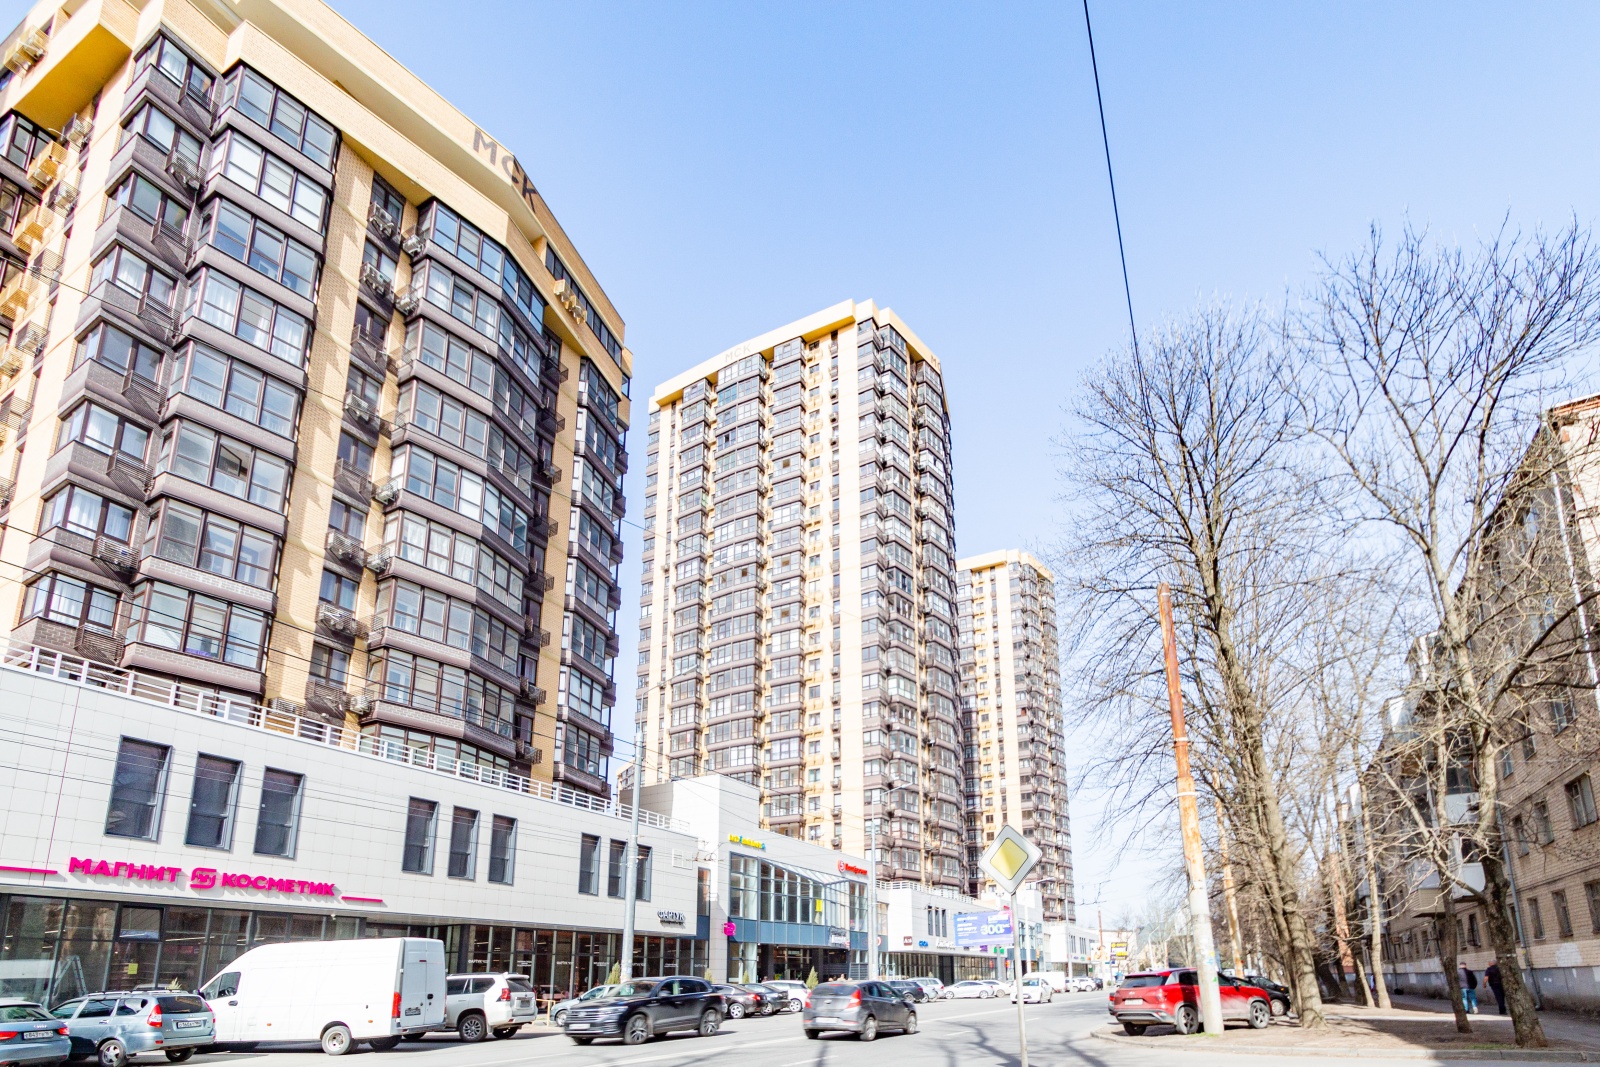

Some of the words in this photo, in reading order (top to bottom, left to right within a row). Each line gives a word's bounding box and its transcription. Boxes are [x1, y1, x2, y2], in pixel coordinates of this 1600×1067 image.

[473, 128, 538, 213] МСК
[725, 343, 752, 363] МСК
[68, 856, 183, 883] МАГНИТ
[221, 872, 336, 896] КОСМЕТИК
